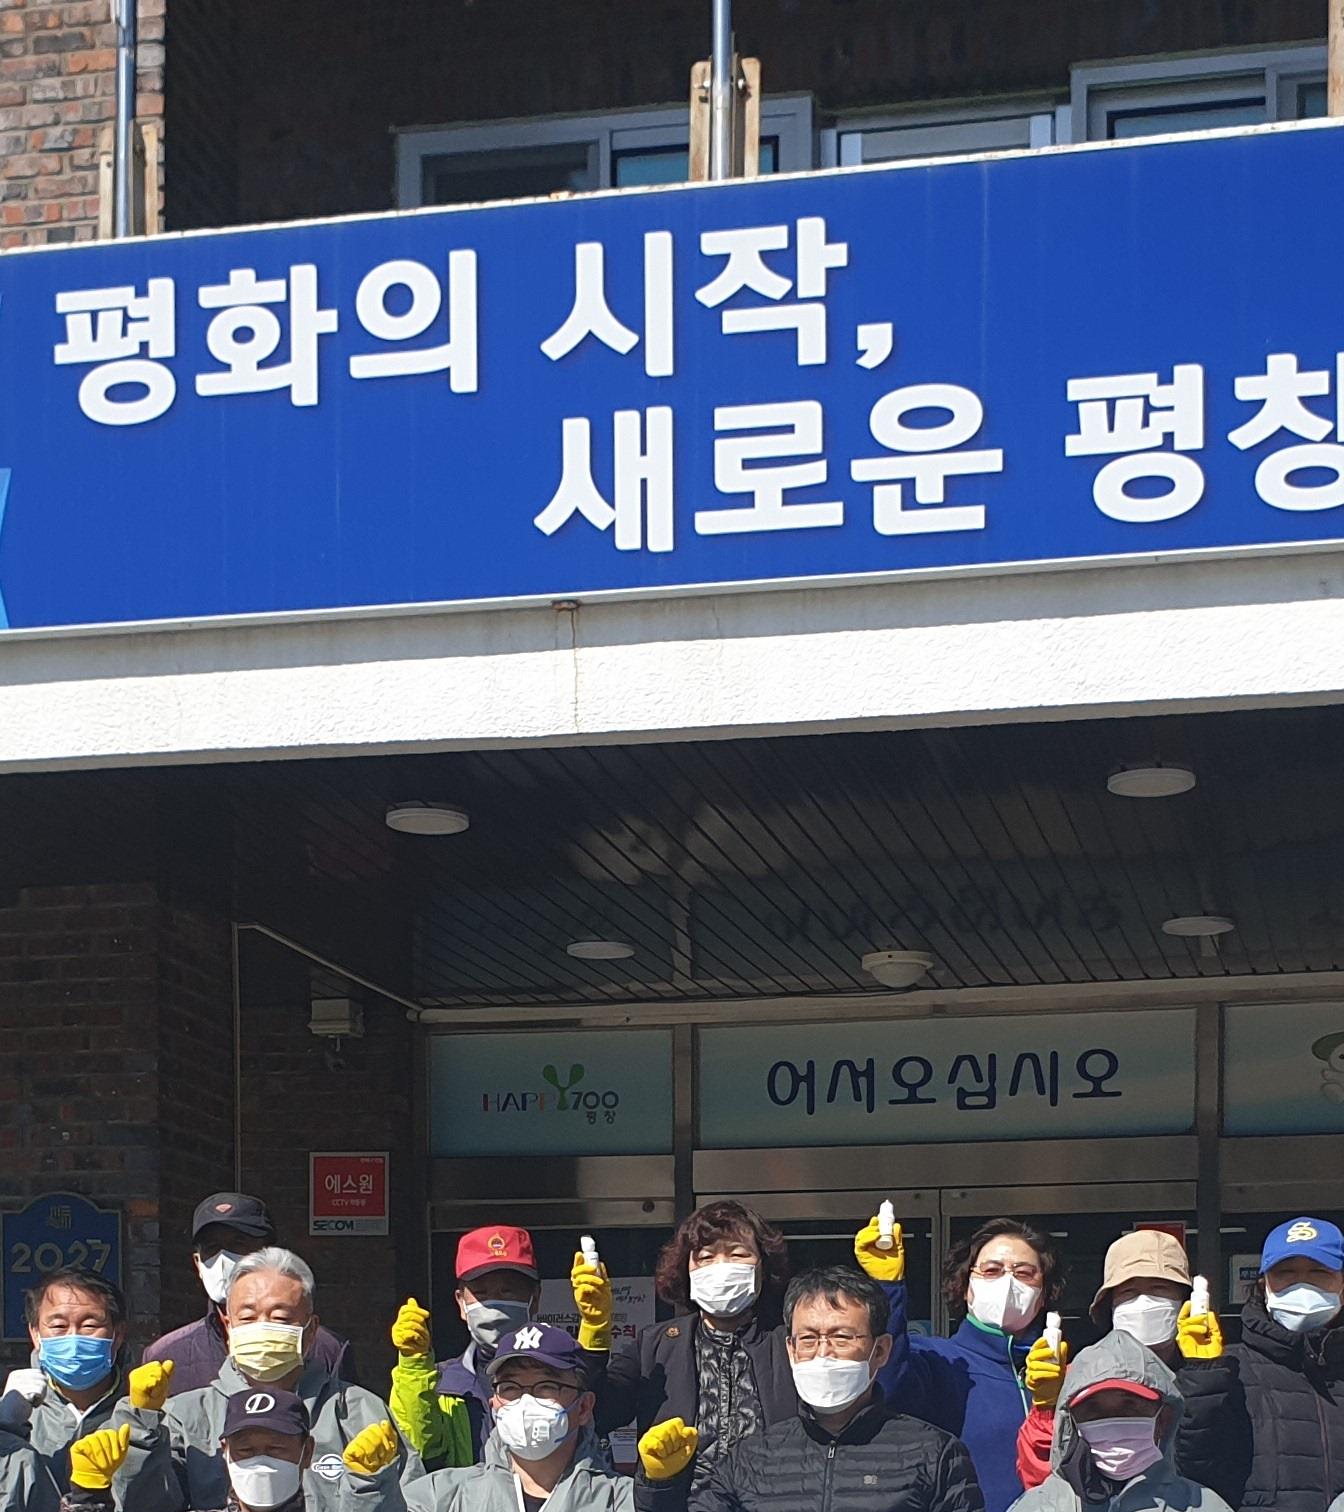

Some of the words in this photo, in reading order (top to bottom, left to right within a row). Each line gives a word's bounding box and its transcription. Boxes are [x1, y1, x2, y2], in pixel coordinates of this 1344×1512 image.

[53, 248, 478, 427] 평화의
[539, 216, 894, 377] 시작,
[533, 383, 1004, 553] 새로운
[766, 1048, 1123, 1116] 어서오십시오
[324, 1173, 374, 1194] 에스원
[245, 1393, 276, 1414] D
